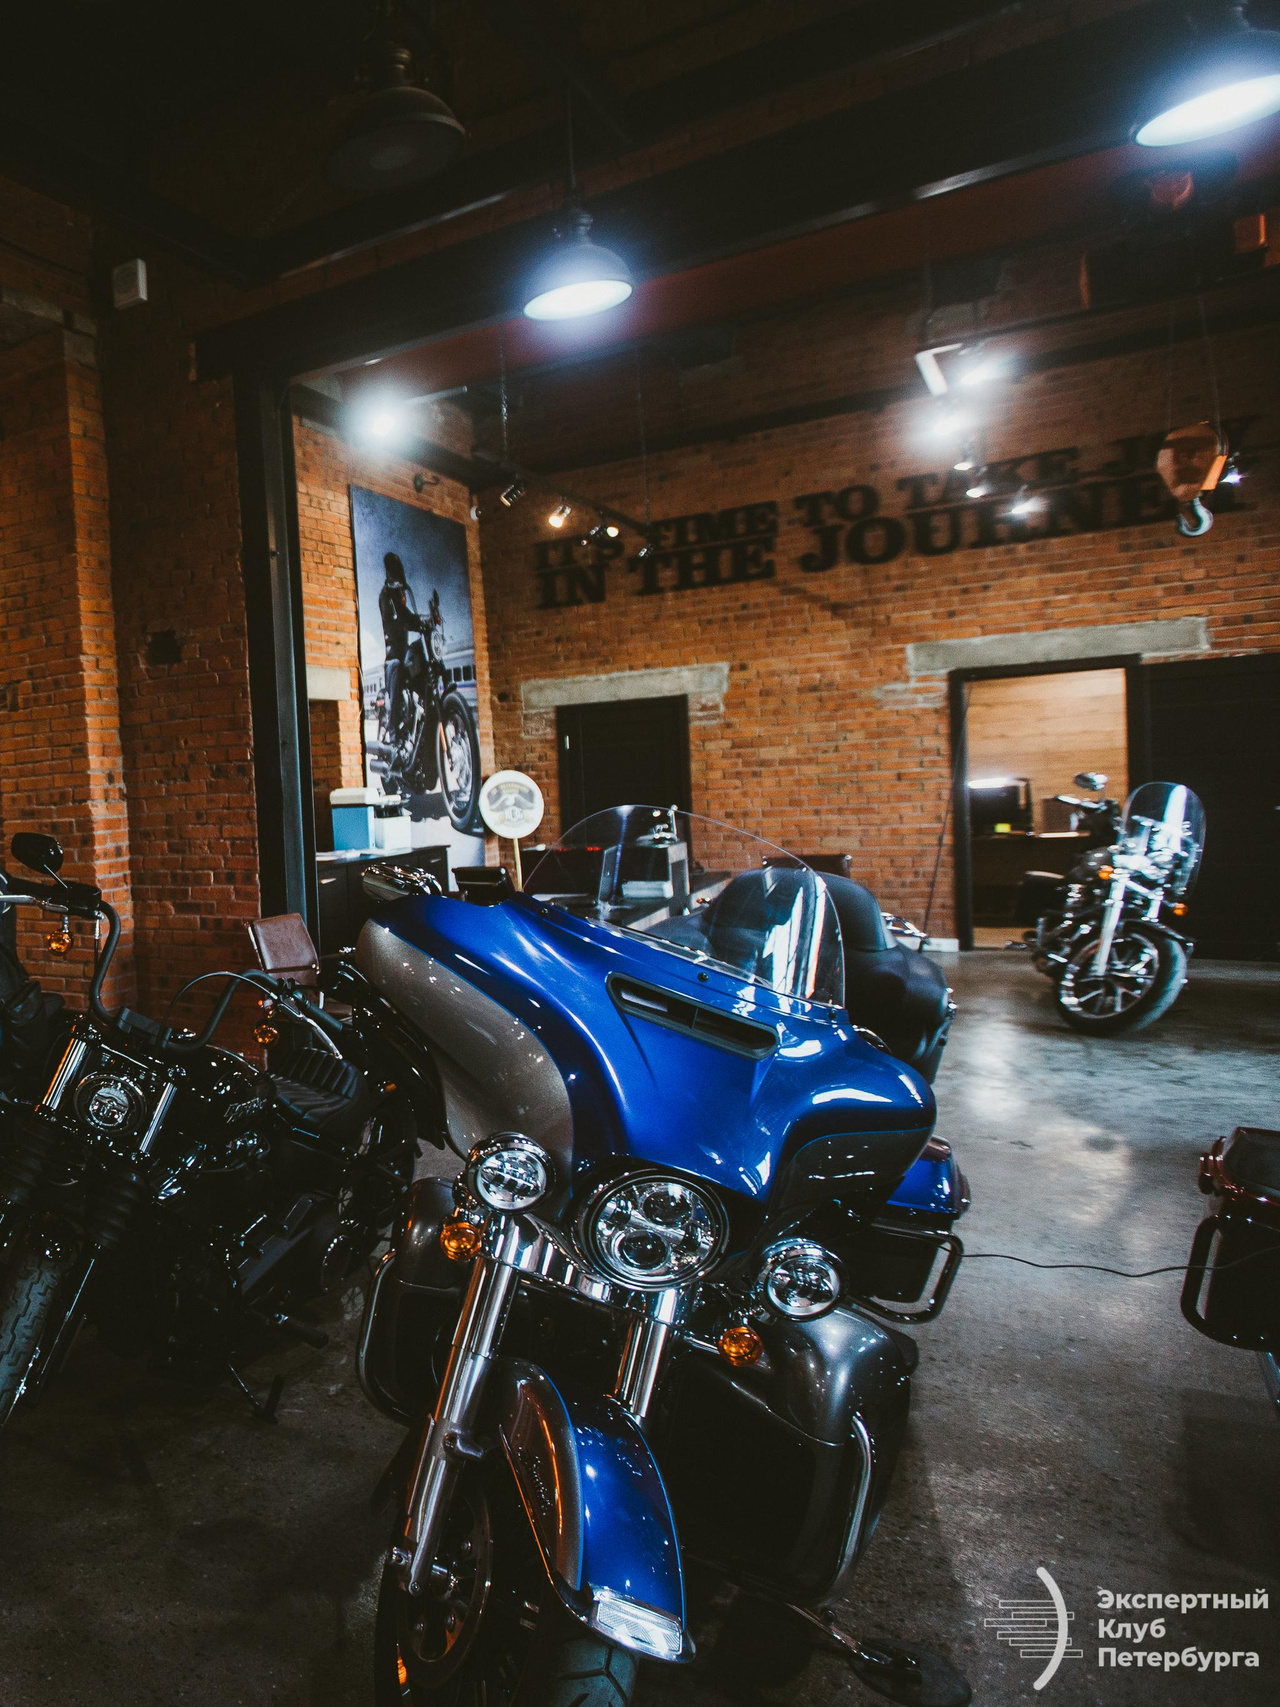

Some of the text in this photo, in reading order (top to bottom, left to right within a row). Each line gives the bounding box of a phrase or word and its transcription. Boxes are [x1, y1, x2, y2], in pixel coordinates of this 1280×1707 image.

[795, 484, 879, 528] TO
[535, 562, 609, 610] IN
[627, 537, 775, 596] THE
